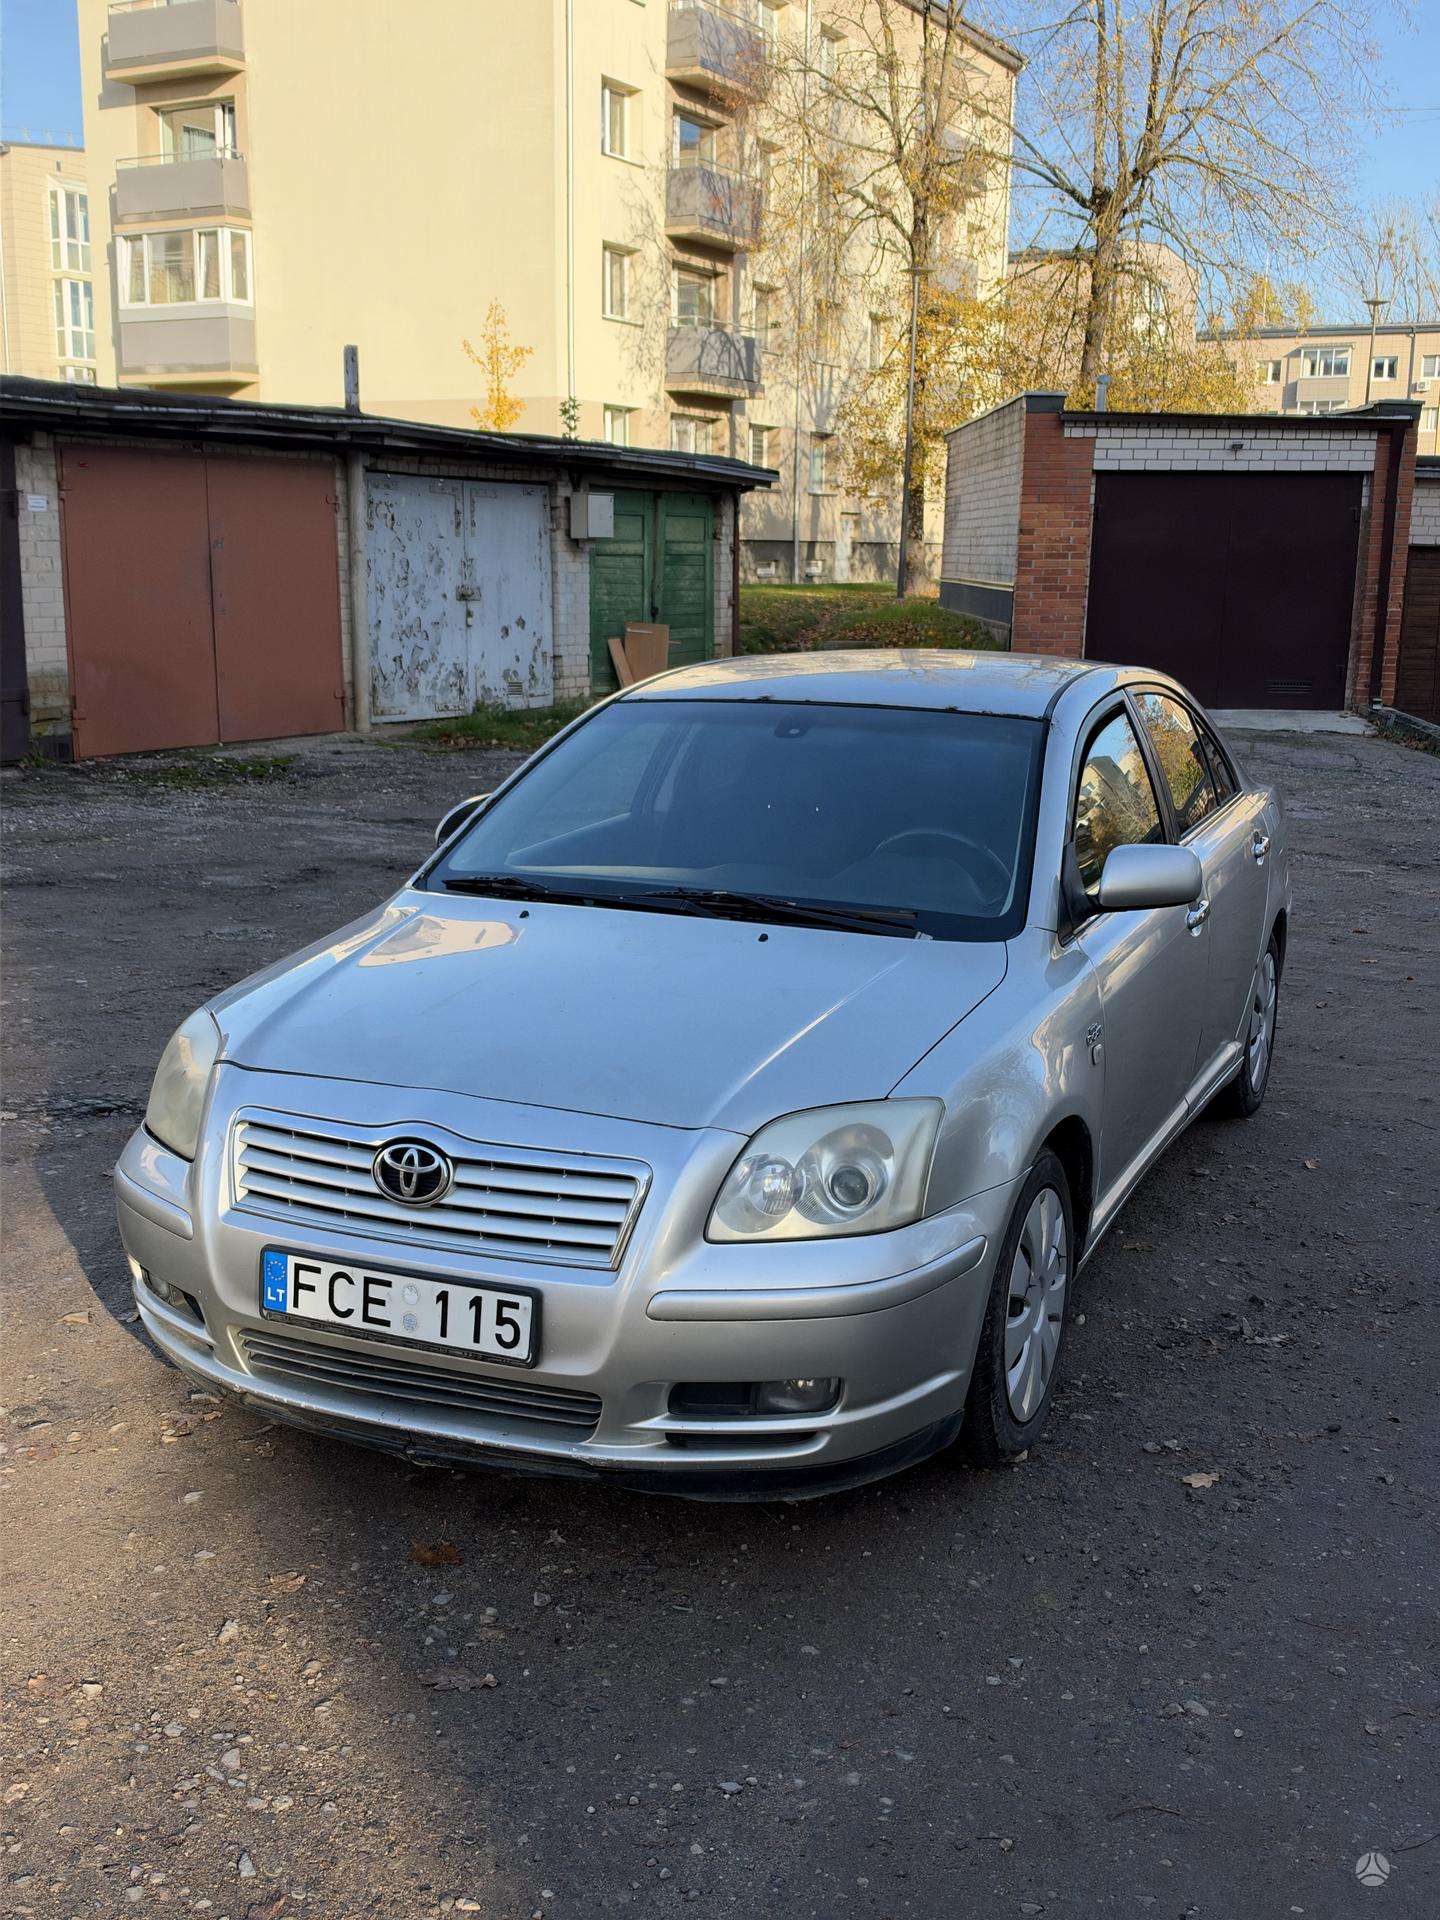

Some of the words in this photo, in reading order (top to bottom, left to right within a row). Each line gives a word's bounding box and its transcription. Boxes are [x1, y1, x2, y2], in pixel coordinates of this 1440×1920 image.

[267, 1286, 285, 1302] LT
[293, 1262, 393, 1328] FCE
[435, 1290, 521, 1349] 115
